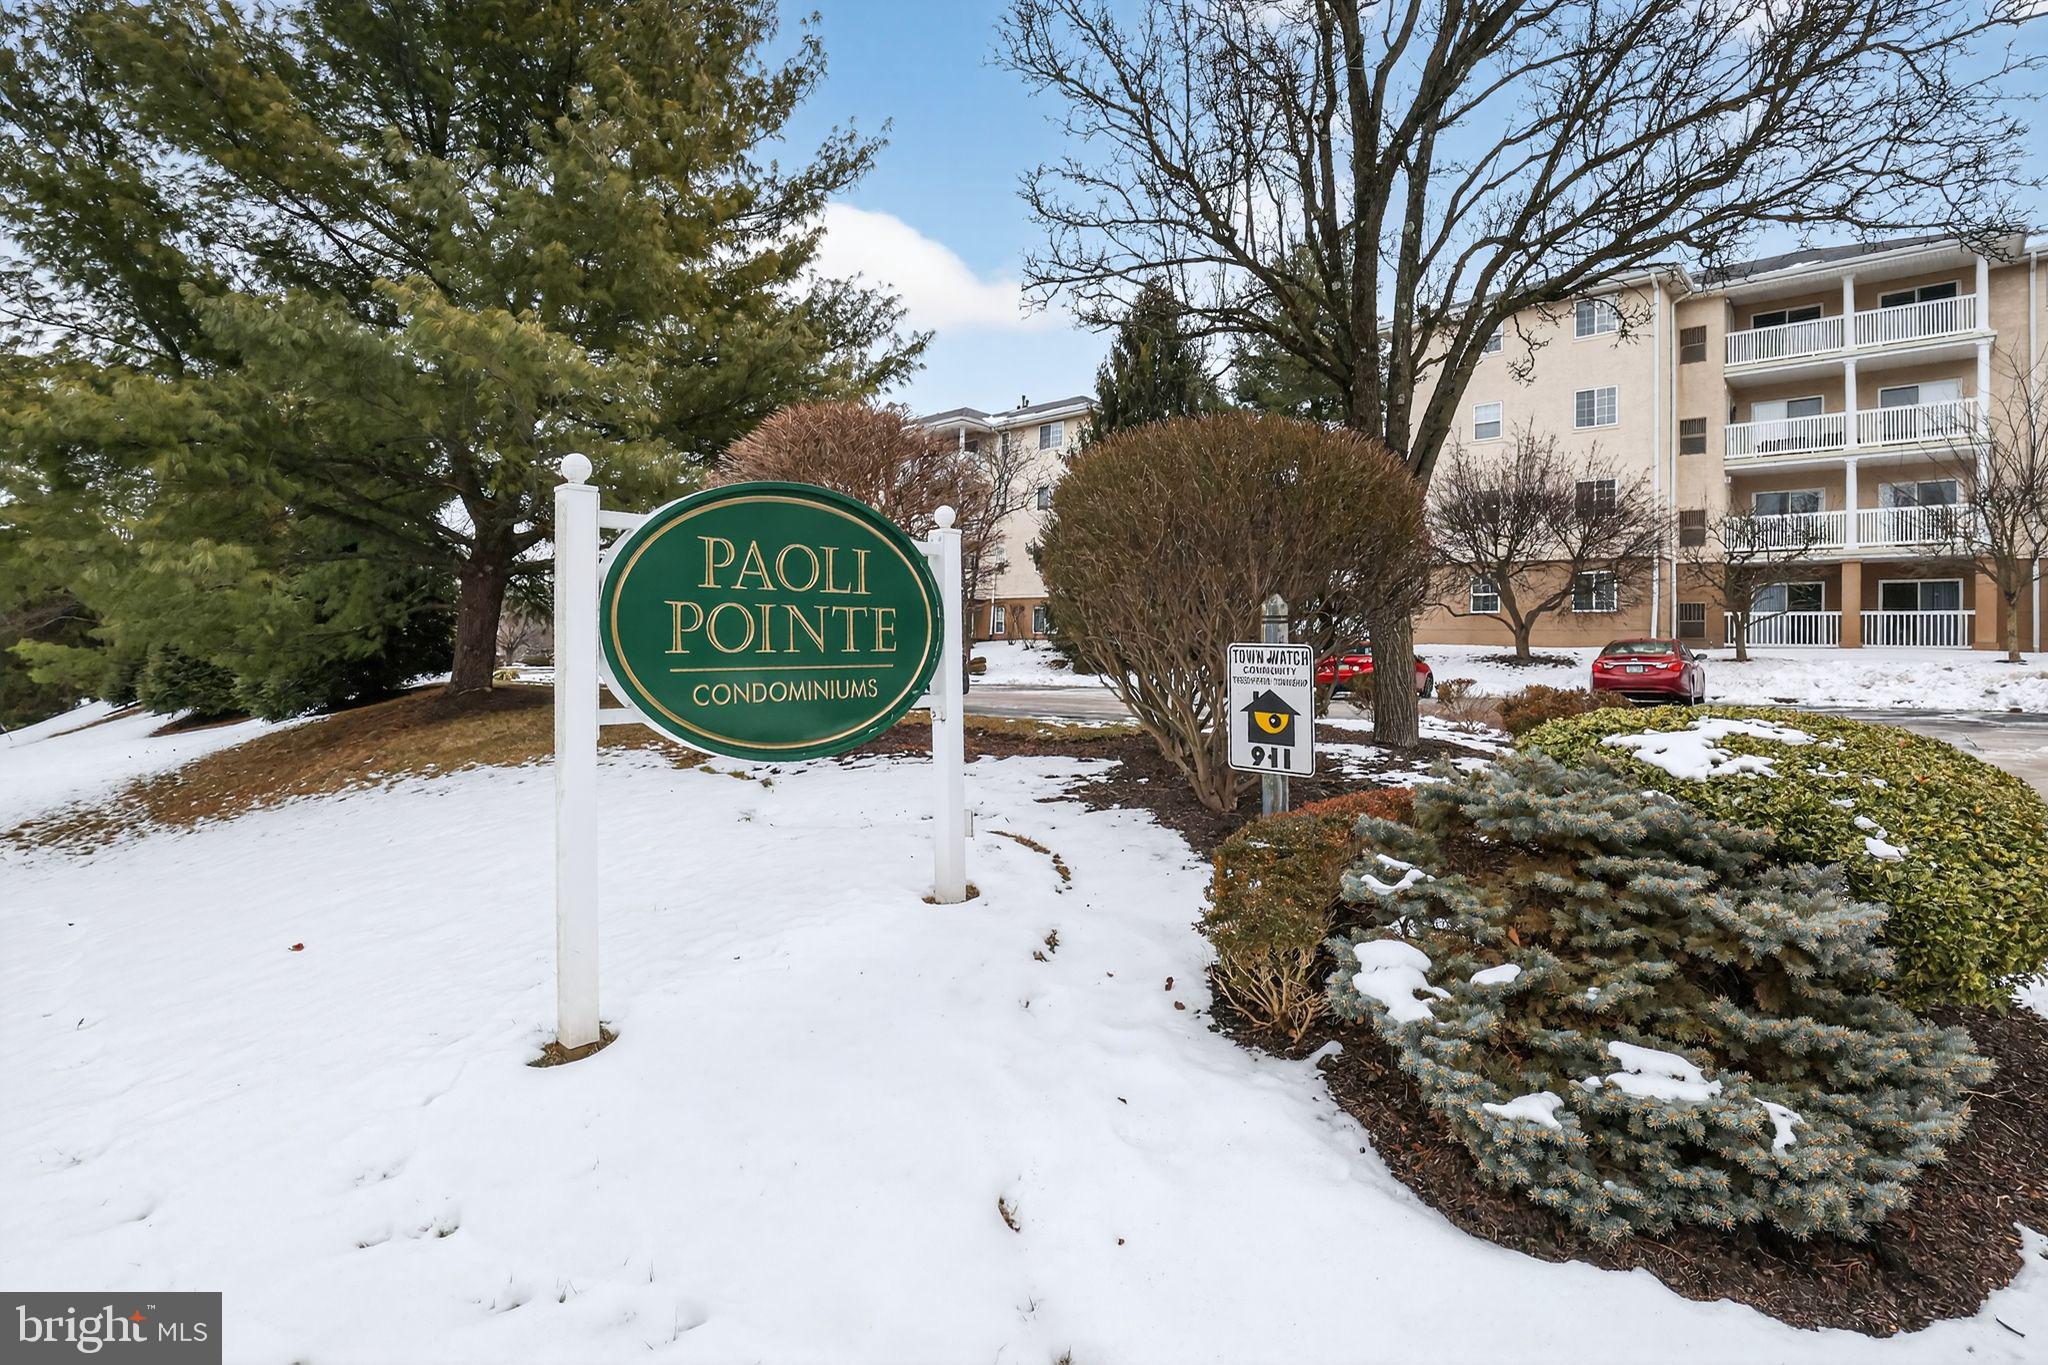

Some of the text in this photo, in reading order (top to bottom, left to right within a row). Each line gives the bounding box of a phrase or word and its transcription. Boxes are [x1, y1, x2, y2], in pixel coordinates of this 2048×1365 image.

[697, 535, 872, 595] PAOLI
[664, 600, 897, 654] POINTE
[1233, 649, 1308, 666] TOWN WATCH
[693, 678, 878, 707] CONDOMINIUMS
